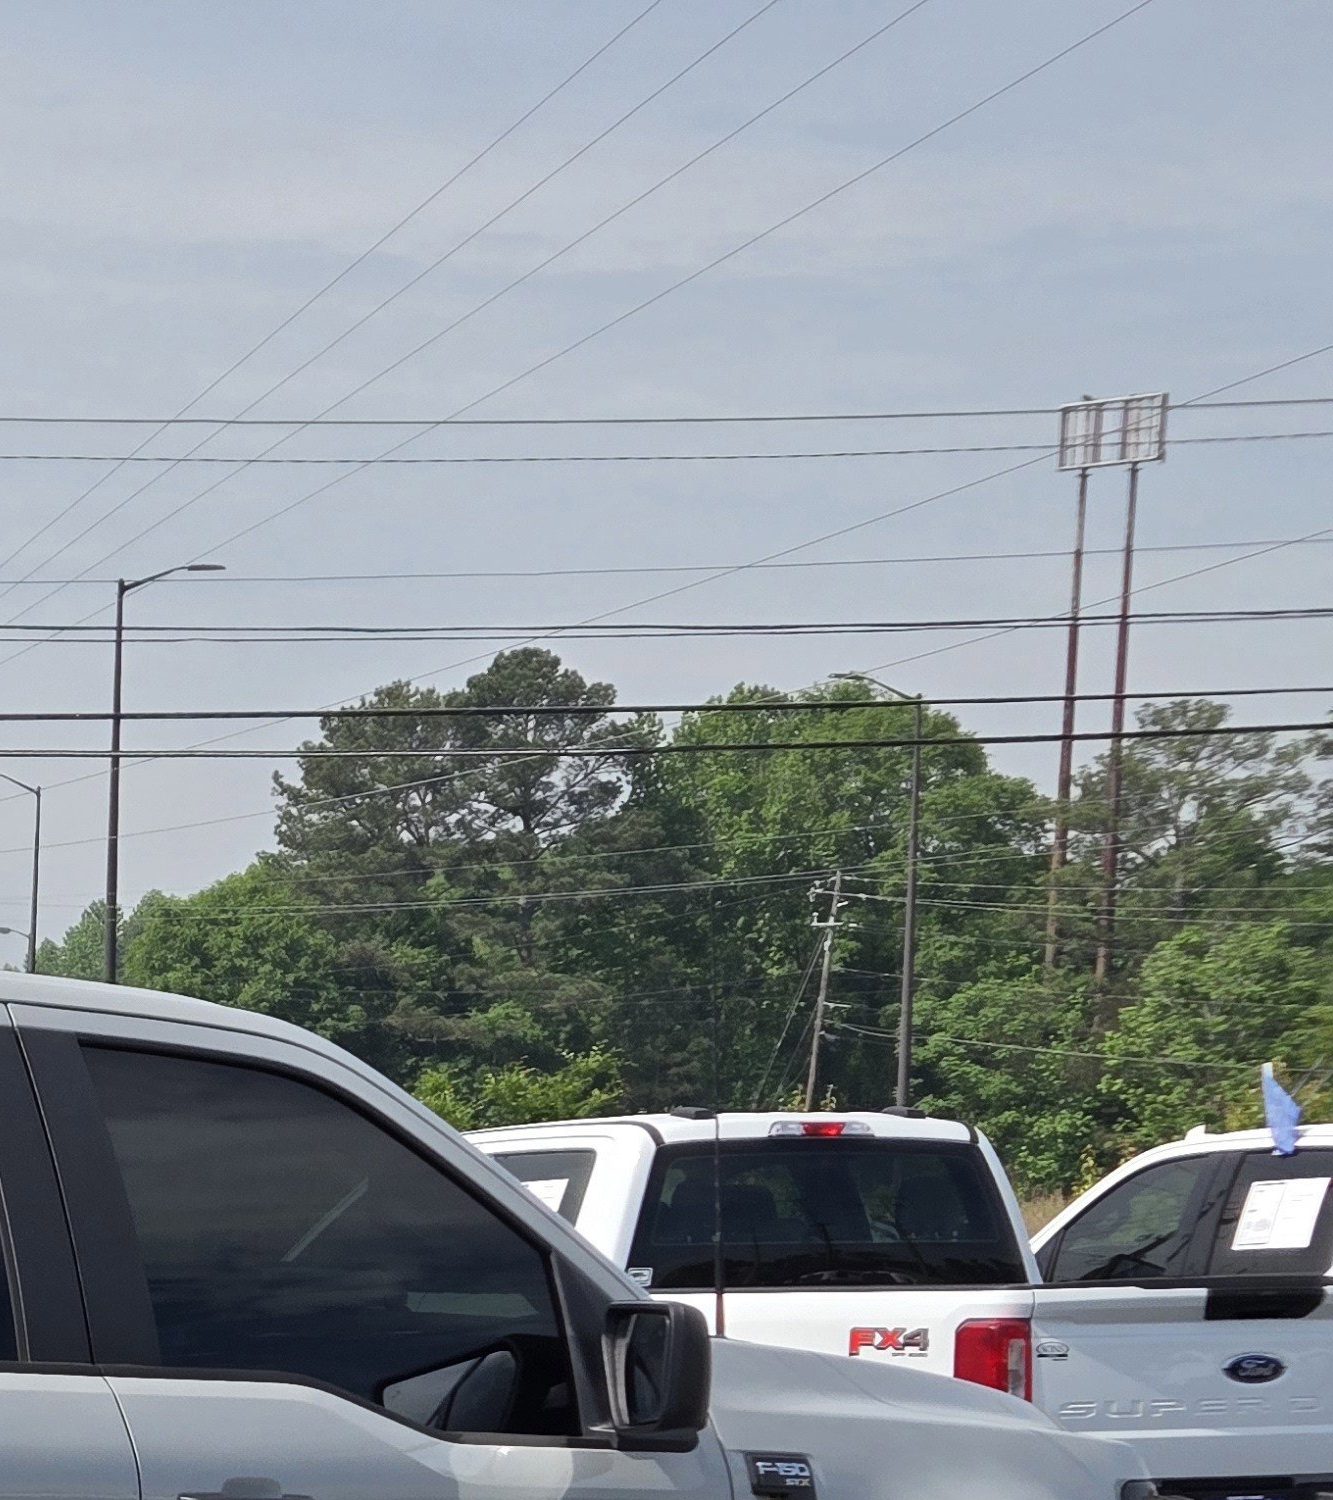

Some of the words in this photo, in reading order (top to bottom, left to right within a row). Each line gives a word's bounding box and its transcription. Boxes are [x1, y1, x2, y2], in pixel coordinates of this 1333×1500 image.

[849, 1326, 930, 1357] FX4
[1059, 1397, 1271, 1419] SUPER
[755, 1461, 811, 1477] F-150
